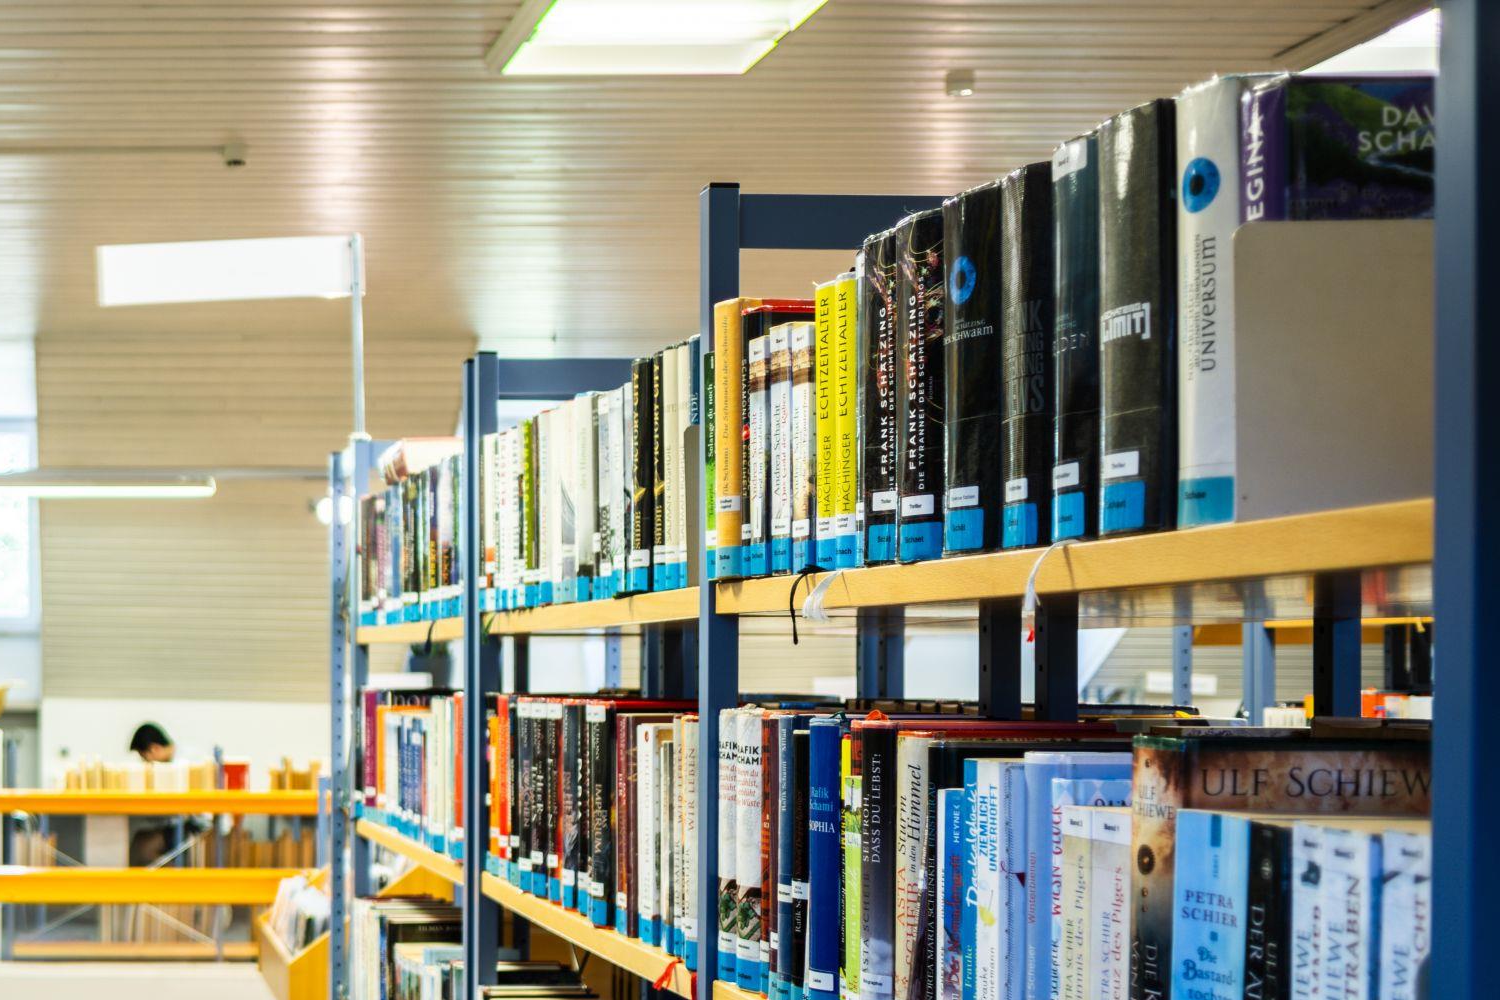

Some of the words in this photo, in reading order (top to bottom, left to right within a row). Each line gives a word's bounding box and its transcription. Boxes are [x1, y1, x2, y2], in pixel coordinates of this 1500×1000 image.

[1245, 96, 1265, 222] EGINA
[819, 297, 829, 420] ECHTZEITALTER
[837, 291, 848, 417] ECHTZEITALTER
[908, 407, 917, 470] FRANK
[842, 433, 851, 514] HACHINGER
[871, 752, 881, 800] LEBST!
[906, 764, 922, 842] Himmel
[1201, 769, 1270, 797] ULF
[1286, 766, 1431, 798] SCHIEW
[862, 792, 871, 834] FROH,
[871, 803, 881, 824] DU
[898, 795, 907, 856] Sturm
[979, 795, 989, 856] ZIEMLICH
[989, 784, 998, 872] UNVERHOFFT
[871, 826, 881, 863] DASS
[896, 867, 906, 927] ASTA
[927, 855, 936, 918] SCHENKEL
[1028, 851, 1037, 925] Winterbienen
[1075, 855, 1086, 910] Pilgers
[1111, 865, 1124, 924] Pilgers
[1184, 889, 1234, 910] PETRA
[905, 881, 919, 967] SCHEIB
[1101, 911, 1110, 963] SCHIER
[1111, 930, 1122, 961] des
[1181, 906, 1238, 928] SCHIER
[1250, 904, 1264, 959] DER
[1146, 944, 1158, 980] DIE
[1183, 958, 1237, 985] Bastard-
[1198, 946, 1217, 964] Die
